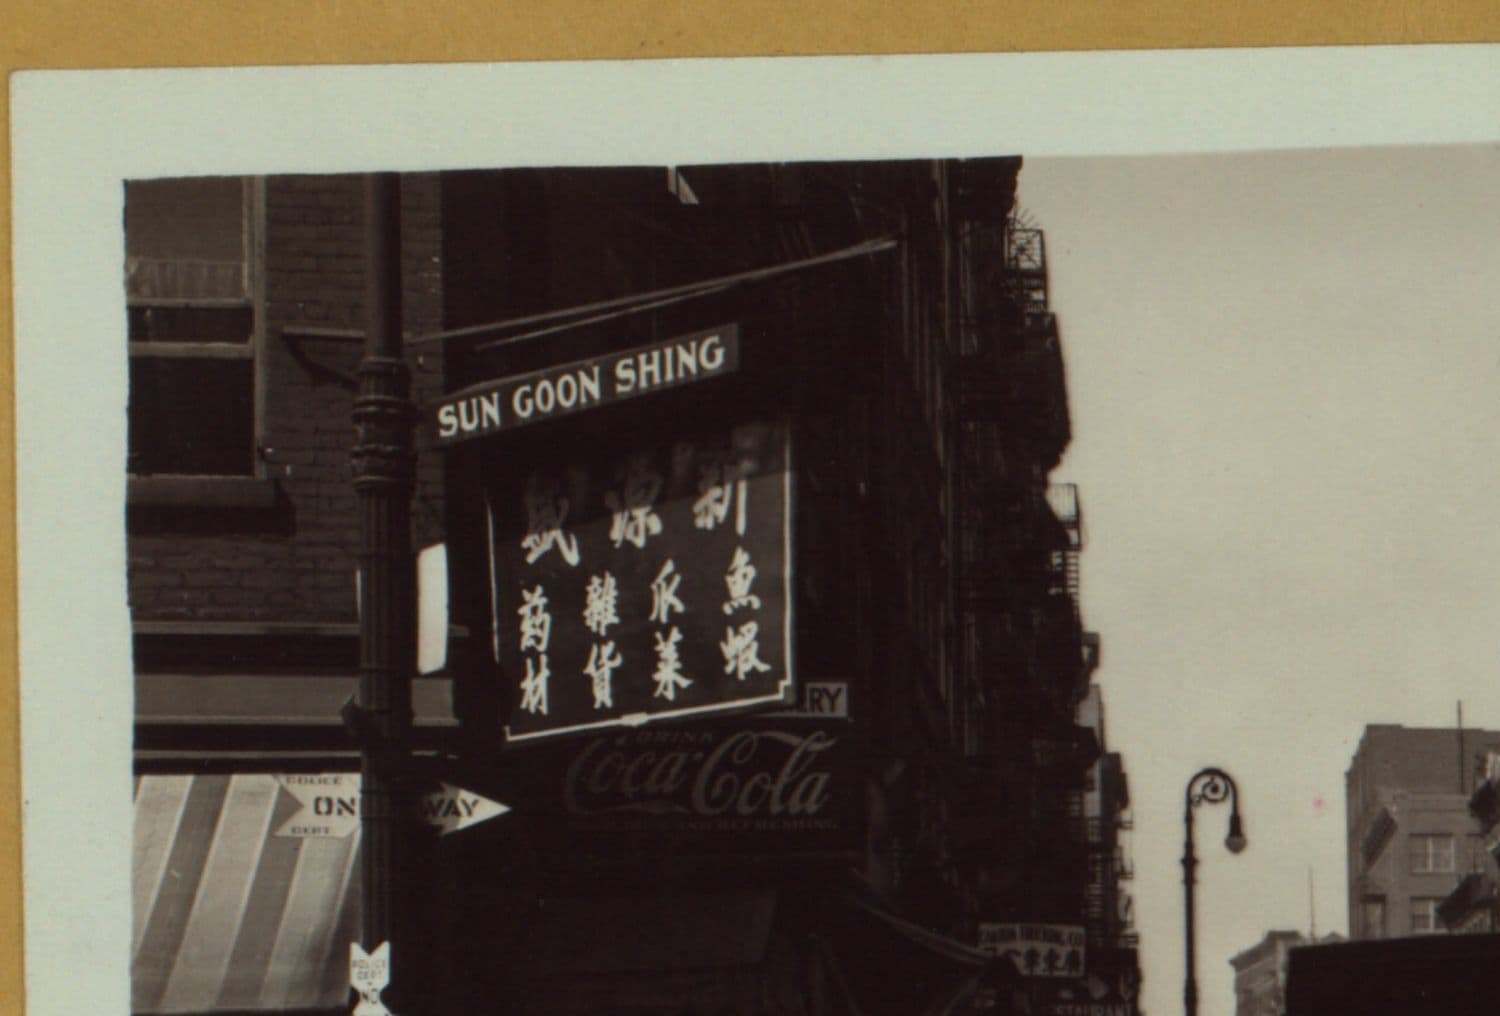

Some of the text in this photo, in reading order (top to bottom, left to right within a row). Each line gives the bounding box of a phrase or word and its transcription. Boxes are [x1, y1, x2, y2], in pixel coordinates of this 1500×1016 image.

[438, 335, 726, 437] SUN GOON SHING
